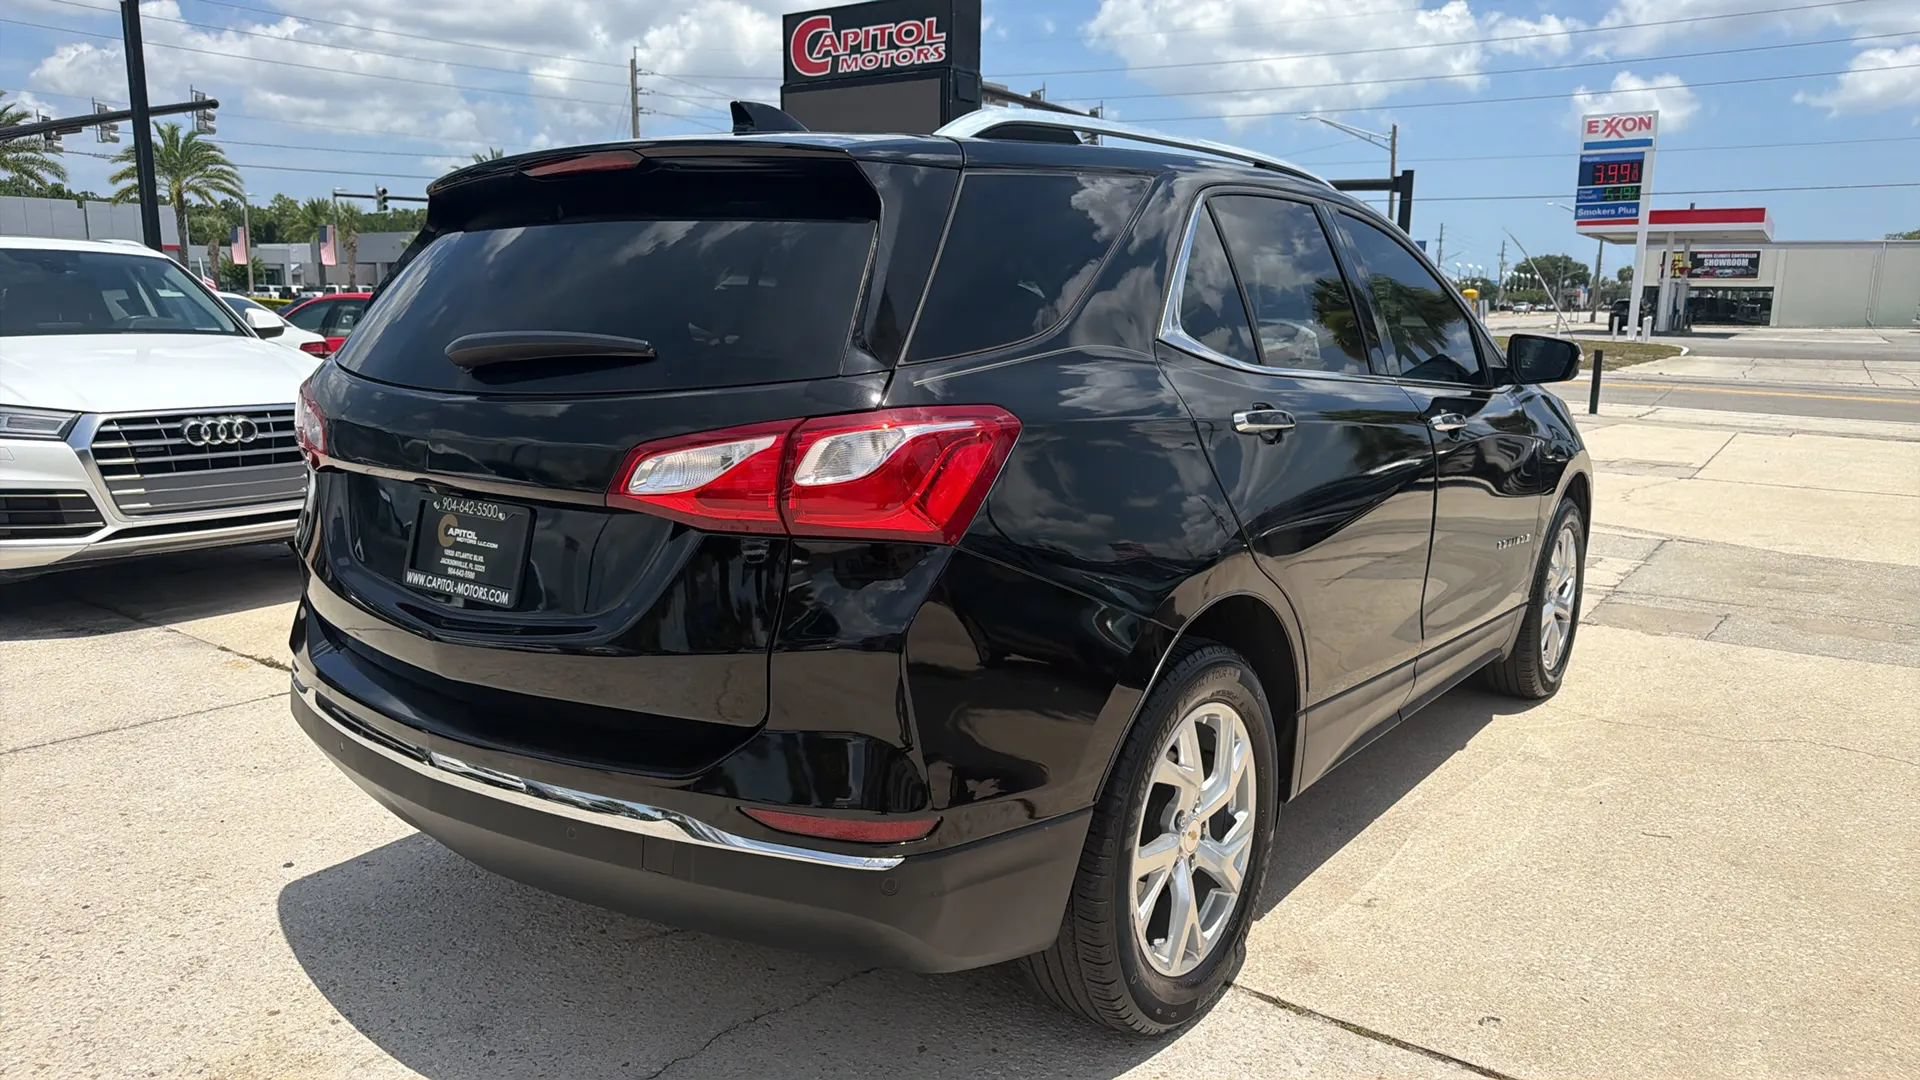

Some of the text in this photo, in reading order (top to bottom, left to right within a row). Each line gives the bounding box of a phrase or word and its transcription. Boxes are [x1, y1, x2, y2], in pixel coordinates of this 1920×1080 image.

[790, 15, 946, 76] CAPITOL
[838, 44, 946, 73] MOTORS
[1587, 116, 1652, 138] EXXON
[1578, 206, 1636, 217] Smokers Plus
[1704, 258, 1748, 267] SHOWROOM
[442, 497, 498, 518] 904-642-5500
[438, 513, 477, 548] CAPITOL
[456, 536, 477, 545] MOTORS
[455, 551, 474, 560] ATLANTIC
[406, 571, 509, 605] WWW.CAPITOL-MOTORS.COM
